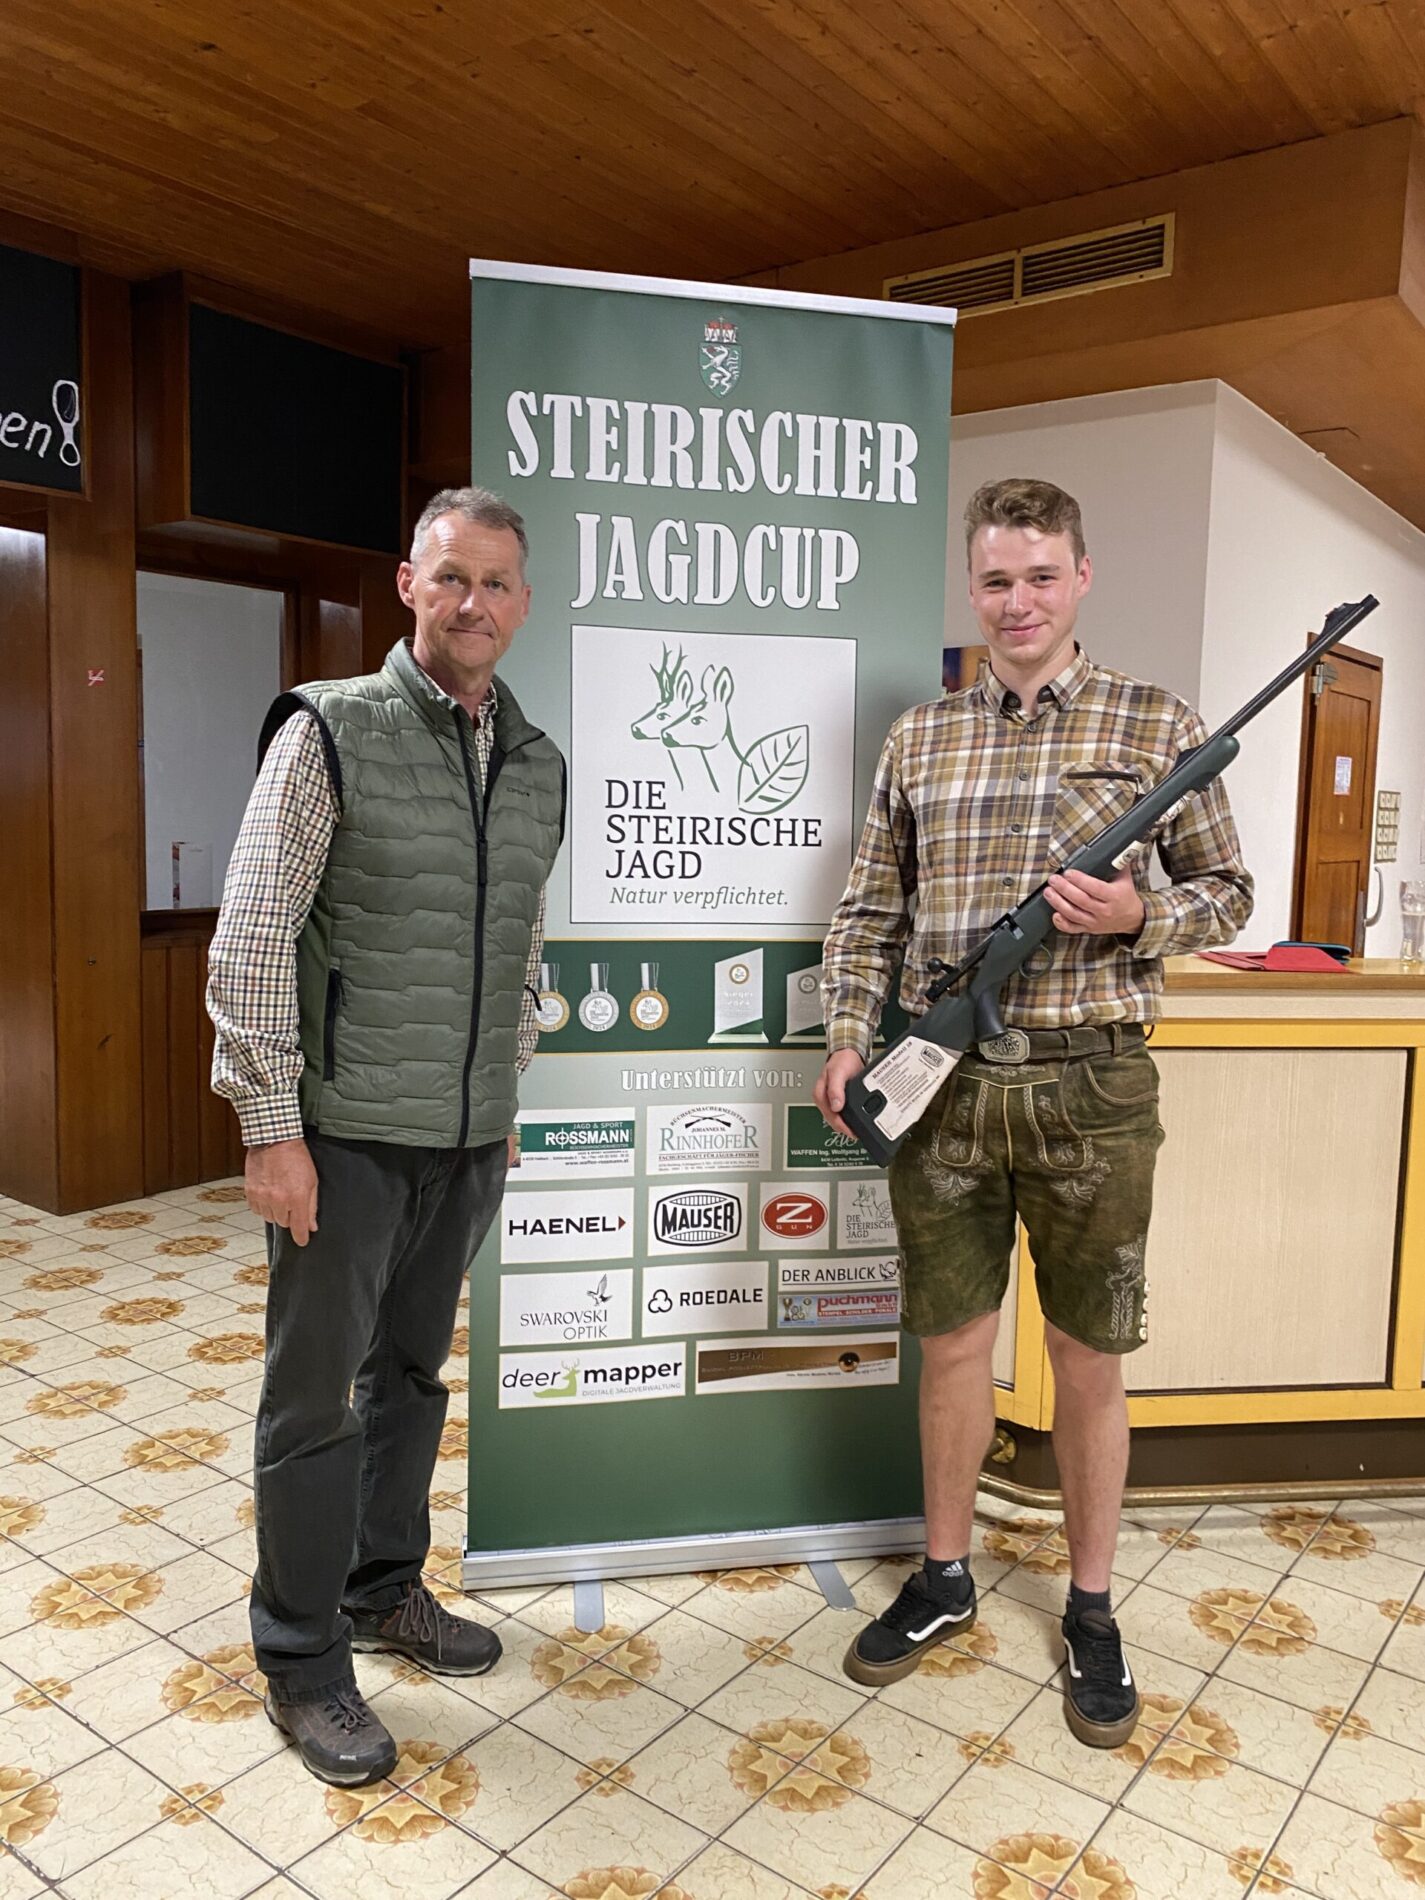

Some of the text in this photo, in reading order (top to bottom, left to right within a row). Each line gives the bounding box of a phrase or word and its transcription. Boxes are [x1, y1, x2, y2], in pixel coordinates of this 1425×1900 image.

[0, 411, 52, 458] en
[505, 390, 919, 505] STEIRISCHER
[570, 511, 861, 611] JAGDCUP
[605, 779, 666, 810] DIE
[606, 814, 822, 847] STEIRISCHE
[605, 849, 702, 879] JAGD
[610, 886, 788, 909] Natur verpflichtet.
[621, 1068, 803, 1091] Unterstützt von:
[600, 1121, 623, 1129] SPORT
[545, 1128, 629, 1147] ROSSMANN
[659, 1125, 758, 1151] RINNHOFER
[661, 1201, 734, 1237] MAUSER
[776, 1202, 813, 1223] Z
[846, 1214, 860, 1223] DIE
[509, 1216, 616, 1236] HAENEL
[846, 1220, 896, 1230] STEIRISCHE
[846, 1230, 869, 1239] JAGD
[781, 1266, 876, 1282] DER ANBLICK
[679, 1288, 763, 1307] ROEDALE
[520, 1309, 608, 1327] SWAROVSKI
[563, 1325, 608, 1340] OPTIK
[502, 1368, 561, 1388] deer
[583, 1361, 683, 1385] mapper
[582, 1387, 614, 1397] DIGITALE
